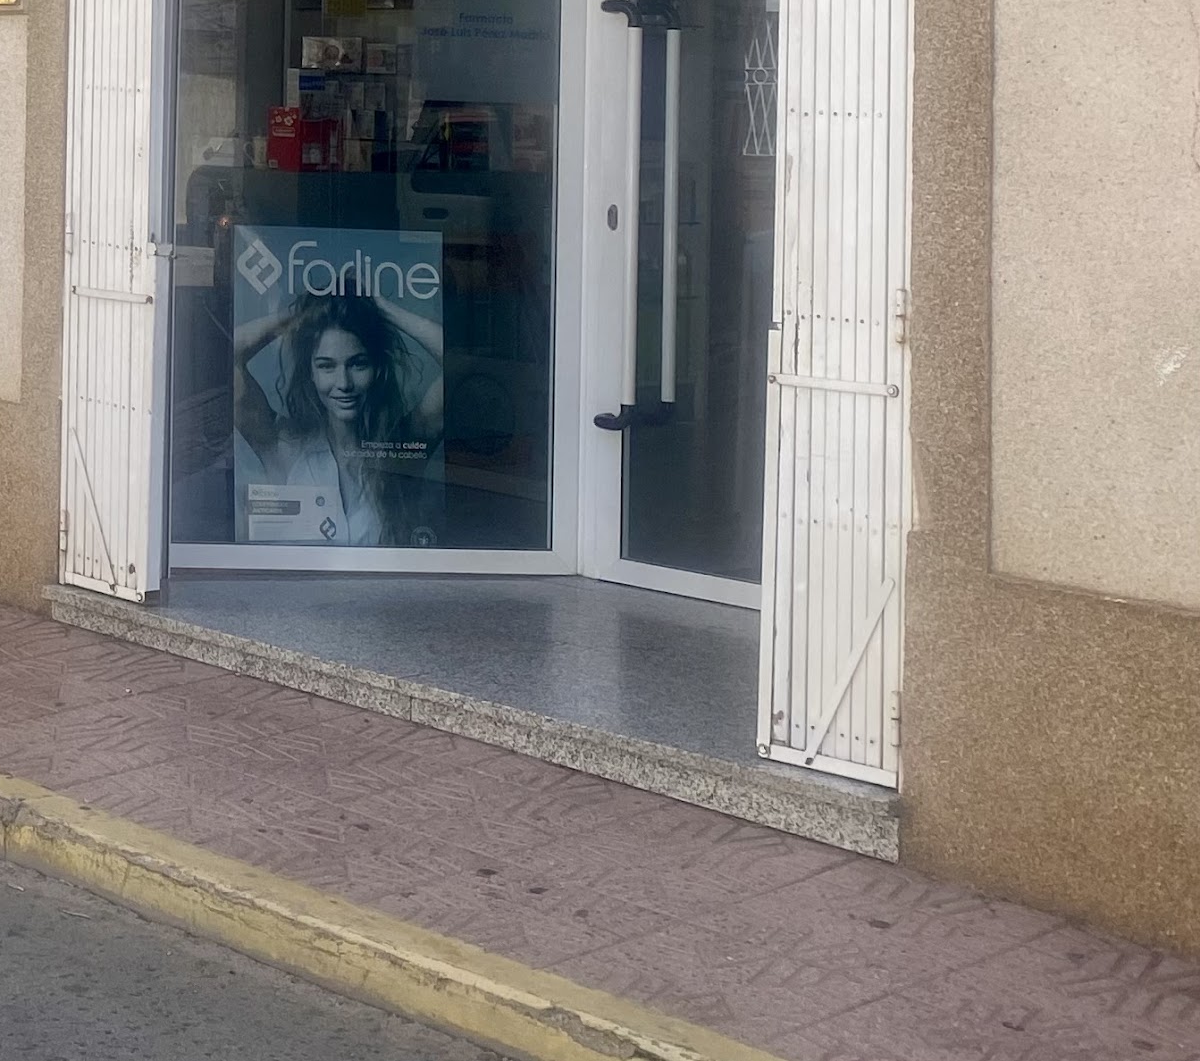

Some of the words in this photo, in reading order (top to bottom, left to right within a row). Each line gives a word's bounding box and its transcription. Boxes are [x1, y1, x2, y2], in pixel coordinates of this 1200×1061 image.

[458, 12, 514, 24] Farmacia
[451, 27, 472, 37] Luis
[288, 240, 440, 299] farline
[402, 441, 427, 449] cuidar
